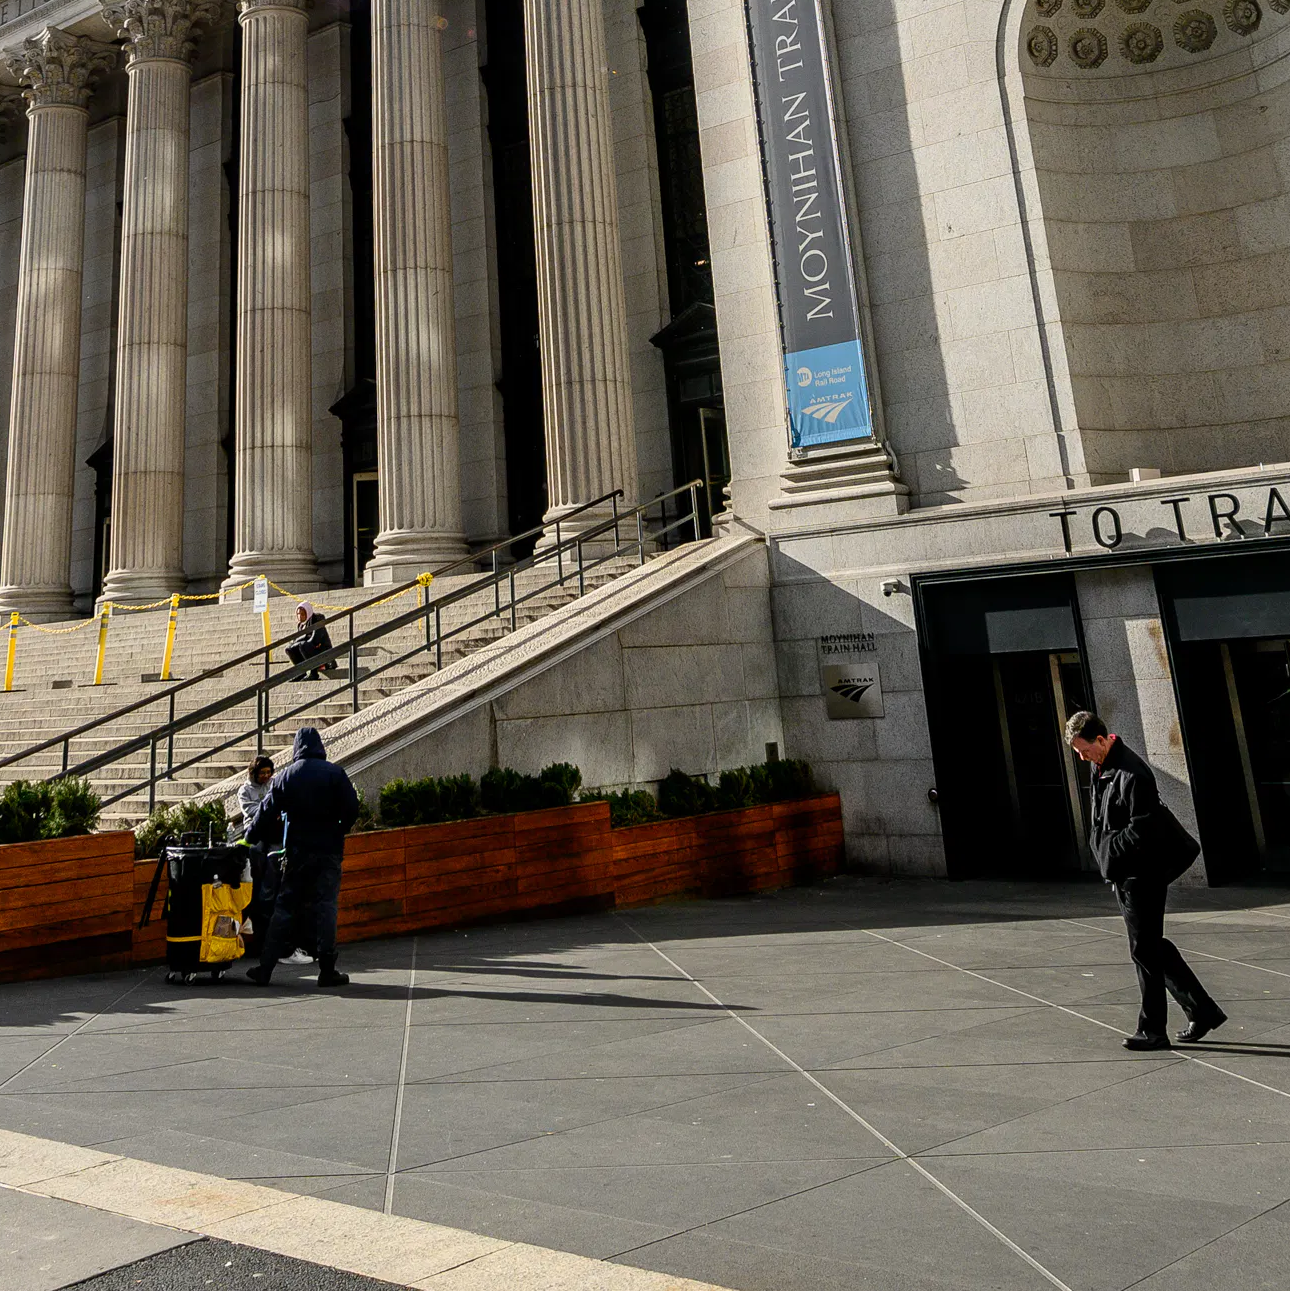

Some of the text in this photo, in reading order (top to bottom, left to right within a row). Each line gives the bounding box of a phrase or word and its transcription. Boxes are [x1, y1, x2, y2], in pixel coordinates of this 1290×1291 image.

[782, 91, 834, 322] MOYNIHAN
[813, 365, 851, 378] Long Island
[815, 375, 846, 387] Rail Road
[810, 392, 853, 404] AMTRAK
[1049, 506, 1123, 553] TO
[820, 633, 874, 644] MOYNIHAN
[821, 642, 877, 655] TRAIN HALL
